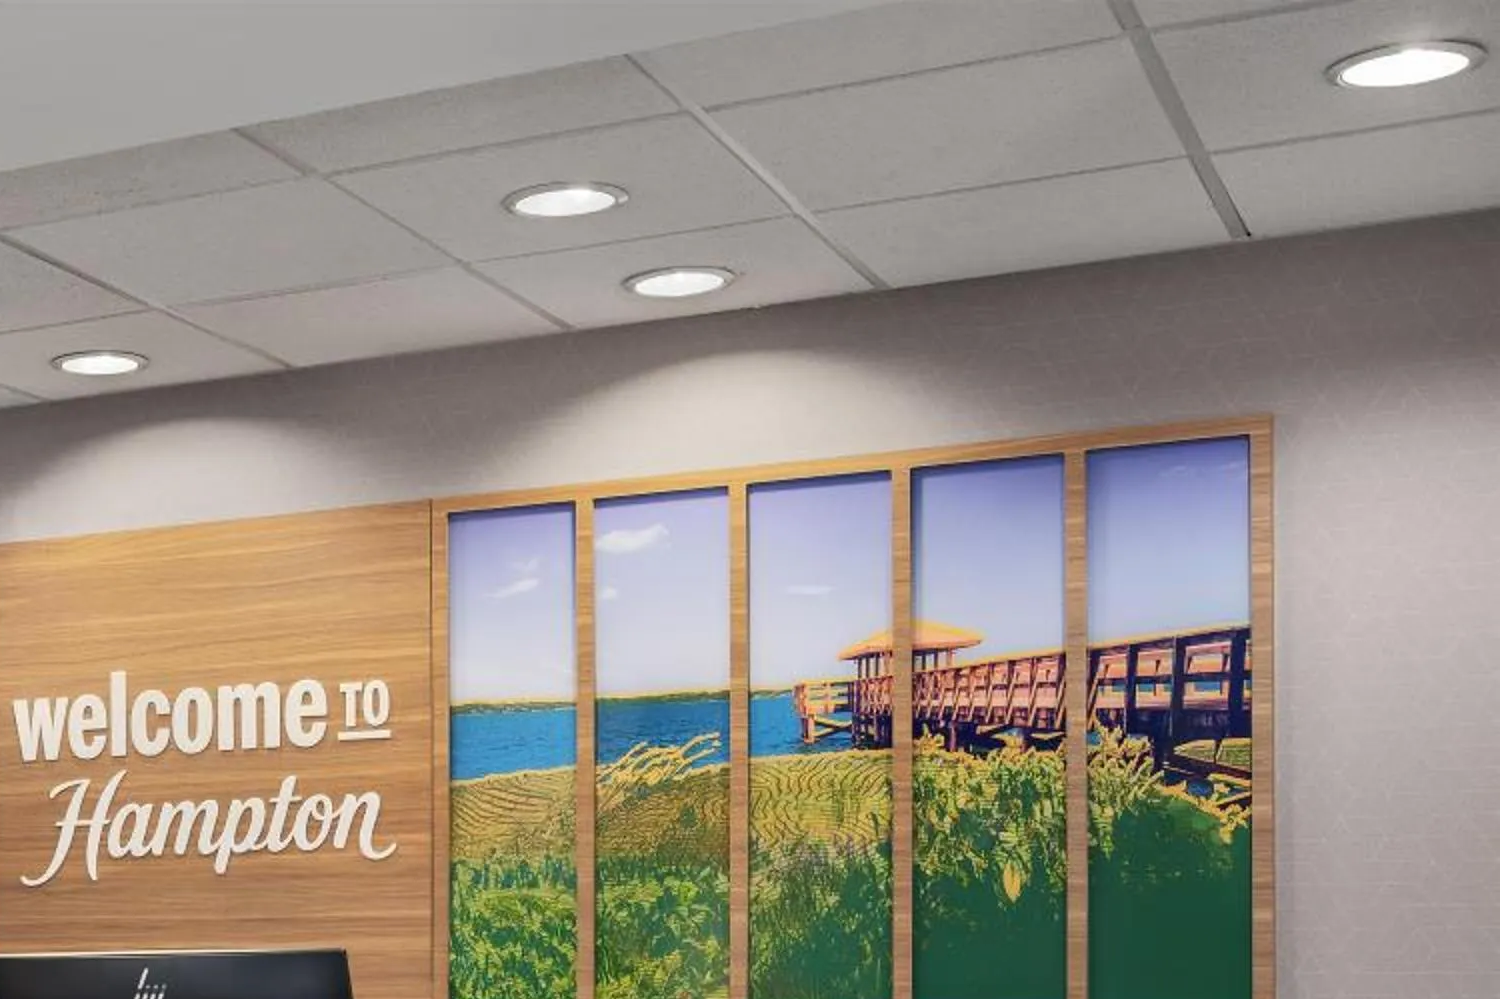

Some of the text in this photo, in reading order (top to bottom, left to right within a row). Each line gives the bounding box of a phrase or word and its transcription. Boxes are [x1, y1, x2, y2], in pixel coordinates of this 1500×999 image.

[13, 670, 391, 762] welcome TO
[20, 769, 397, 888] Hampton
